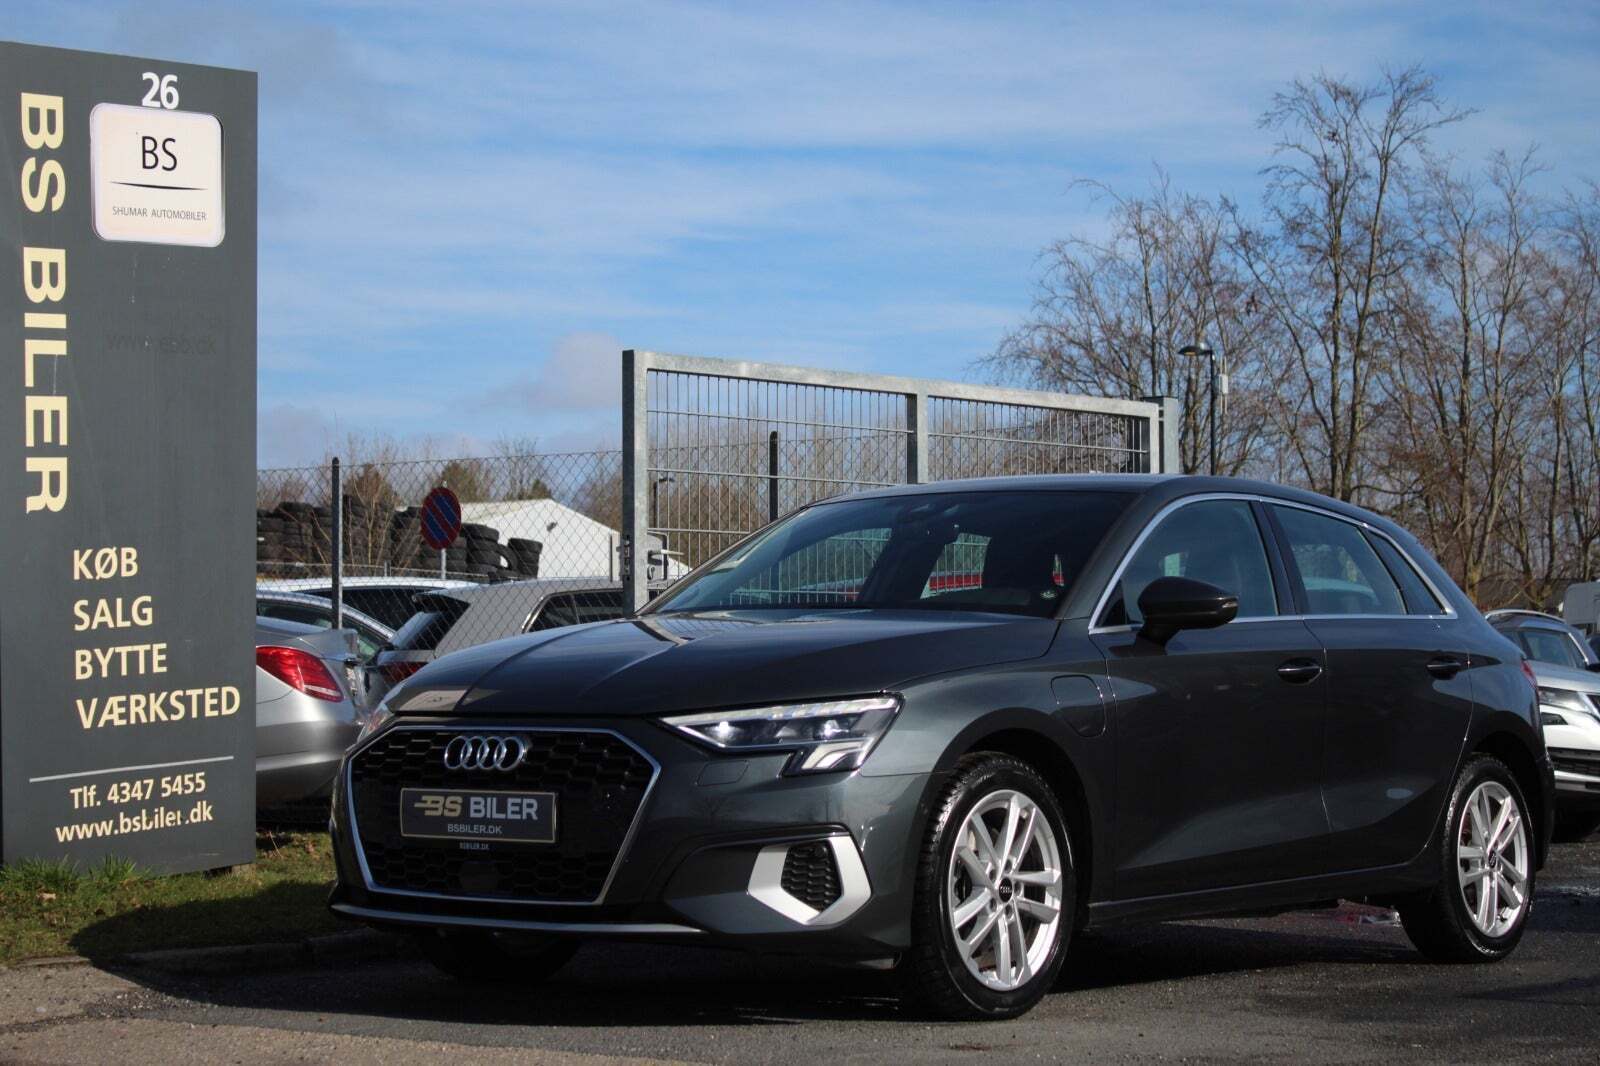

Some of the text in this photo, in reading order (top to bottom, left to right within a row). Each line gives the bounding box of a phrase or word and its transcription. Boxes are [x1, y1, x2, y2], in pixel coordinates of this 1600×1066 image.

[141, 72, 179, 109] 26
[141, 135, 178, 172] BS
[112, 205, 207, 221] SHUMAR AUTOMOBILER
[21, 92, 68, 514] BS BILER
[73, 546, 138, 580] KØB
[73, 595, 153, 631] SALG
[75, 643, 168, 680] BYTTE
[76, 686, 241, 729] VÆRKSTED
[70, 772, 206, 809] Tlf. 4347 5455
[414, 795, 538, 820] BS BILER
[447, 823, 502, 834] BSBILER.DK
